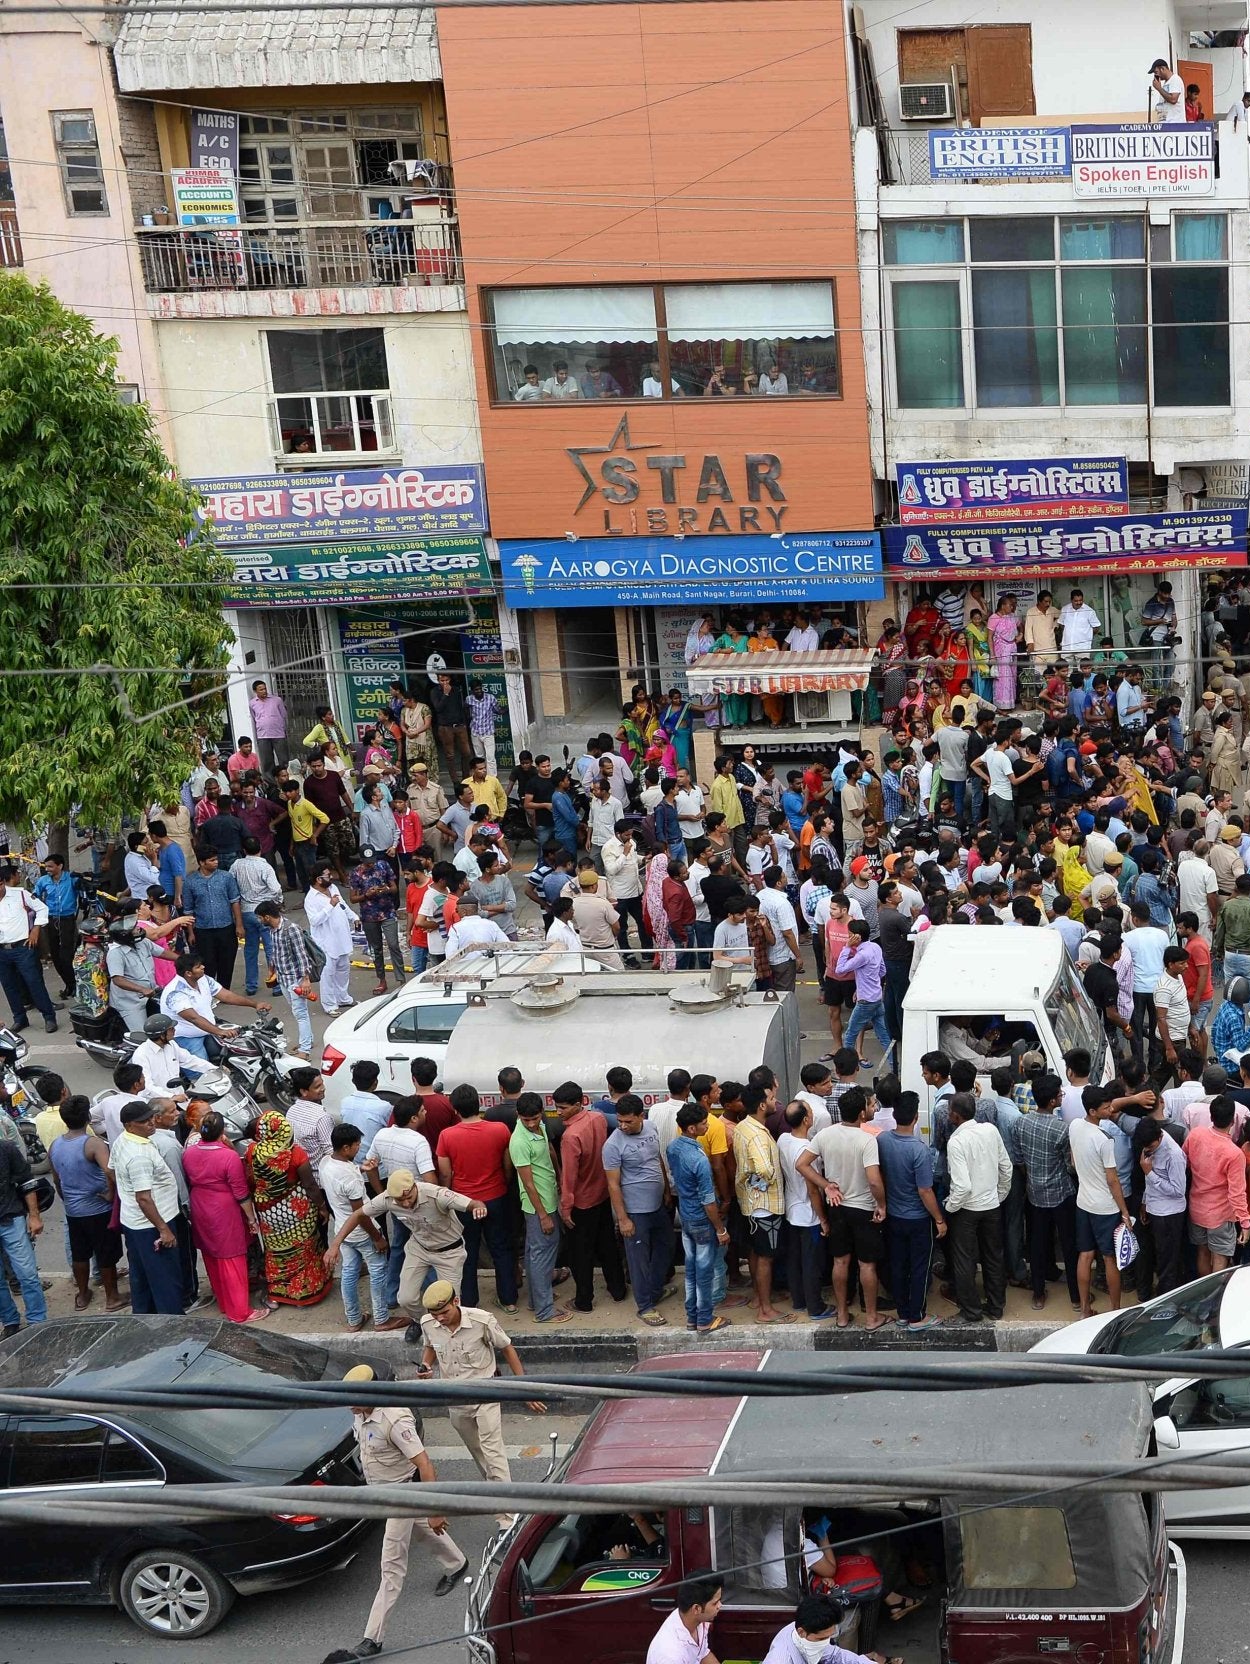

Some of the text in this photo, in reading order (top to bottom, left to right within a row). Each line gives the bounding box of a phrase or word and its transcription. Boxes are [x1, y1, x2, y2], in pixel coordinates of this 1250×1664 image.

[197, 113, 235, 128] MATHS
[1120, 124, 1152, 132] ACADEMY
[198, 133, 229, 149] A/C
[940, 138, 1060, 152] BRITISH
[1075, 134, 1210, 158] BRITISH ENGLISH
[941, 151, 1058, 166] ENGLISH
[1079, 164, 1208, 185] Spoken English
[181, 191, 231, 199] ACCOUNTS
[182, 204, 233, 212] ECONOMICS
[601, 453, 787, 504] STAR
[923, 466, 1122, 506] ध्रुव डाईग्नोस्टिक्स
[198, 470, 475, 521] सहारा डाईग्नोस्टिक
[604, 506, 788, 534] LIBRARY
[1162, 515, 1232, 526] M.9013974330
[951, 528, 1006, 536] COMPUTERISED
[322, 544, 374, 555] 9210027698,
[937, 524, 1234, 564] ध्रुव डाईग्नोस्टिक्स
[294, 550, 480, 580] डाईग्नोस्टिक
[548, 551, 874, 578] AAROGYA DIAGNOSTIC CENTRE
[348, 658, 400, 672] डिजिटल
[768, 673, 866, 694] LIBRARY
[628, 1571, 650, 1580] CNG
